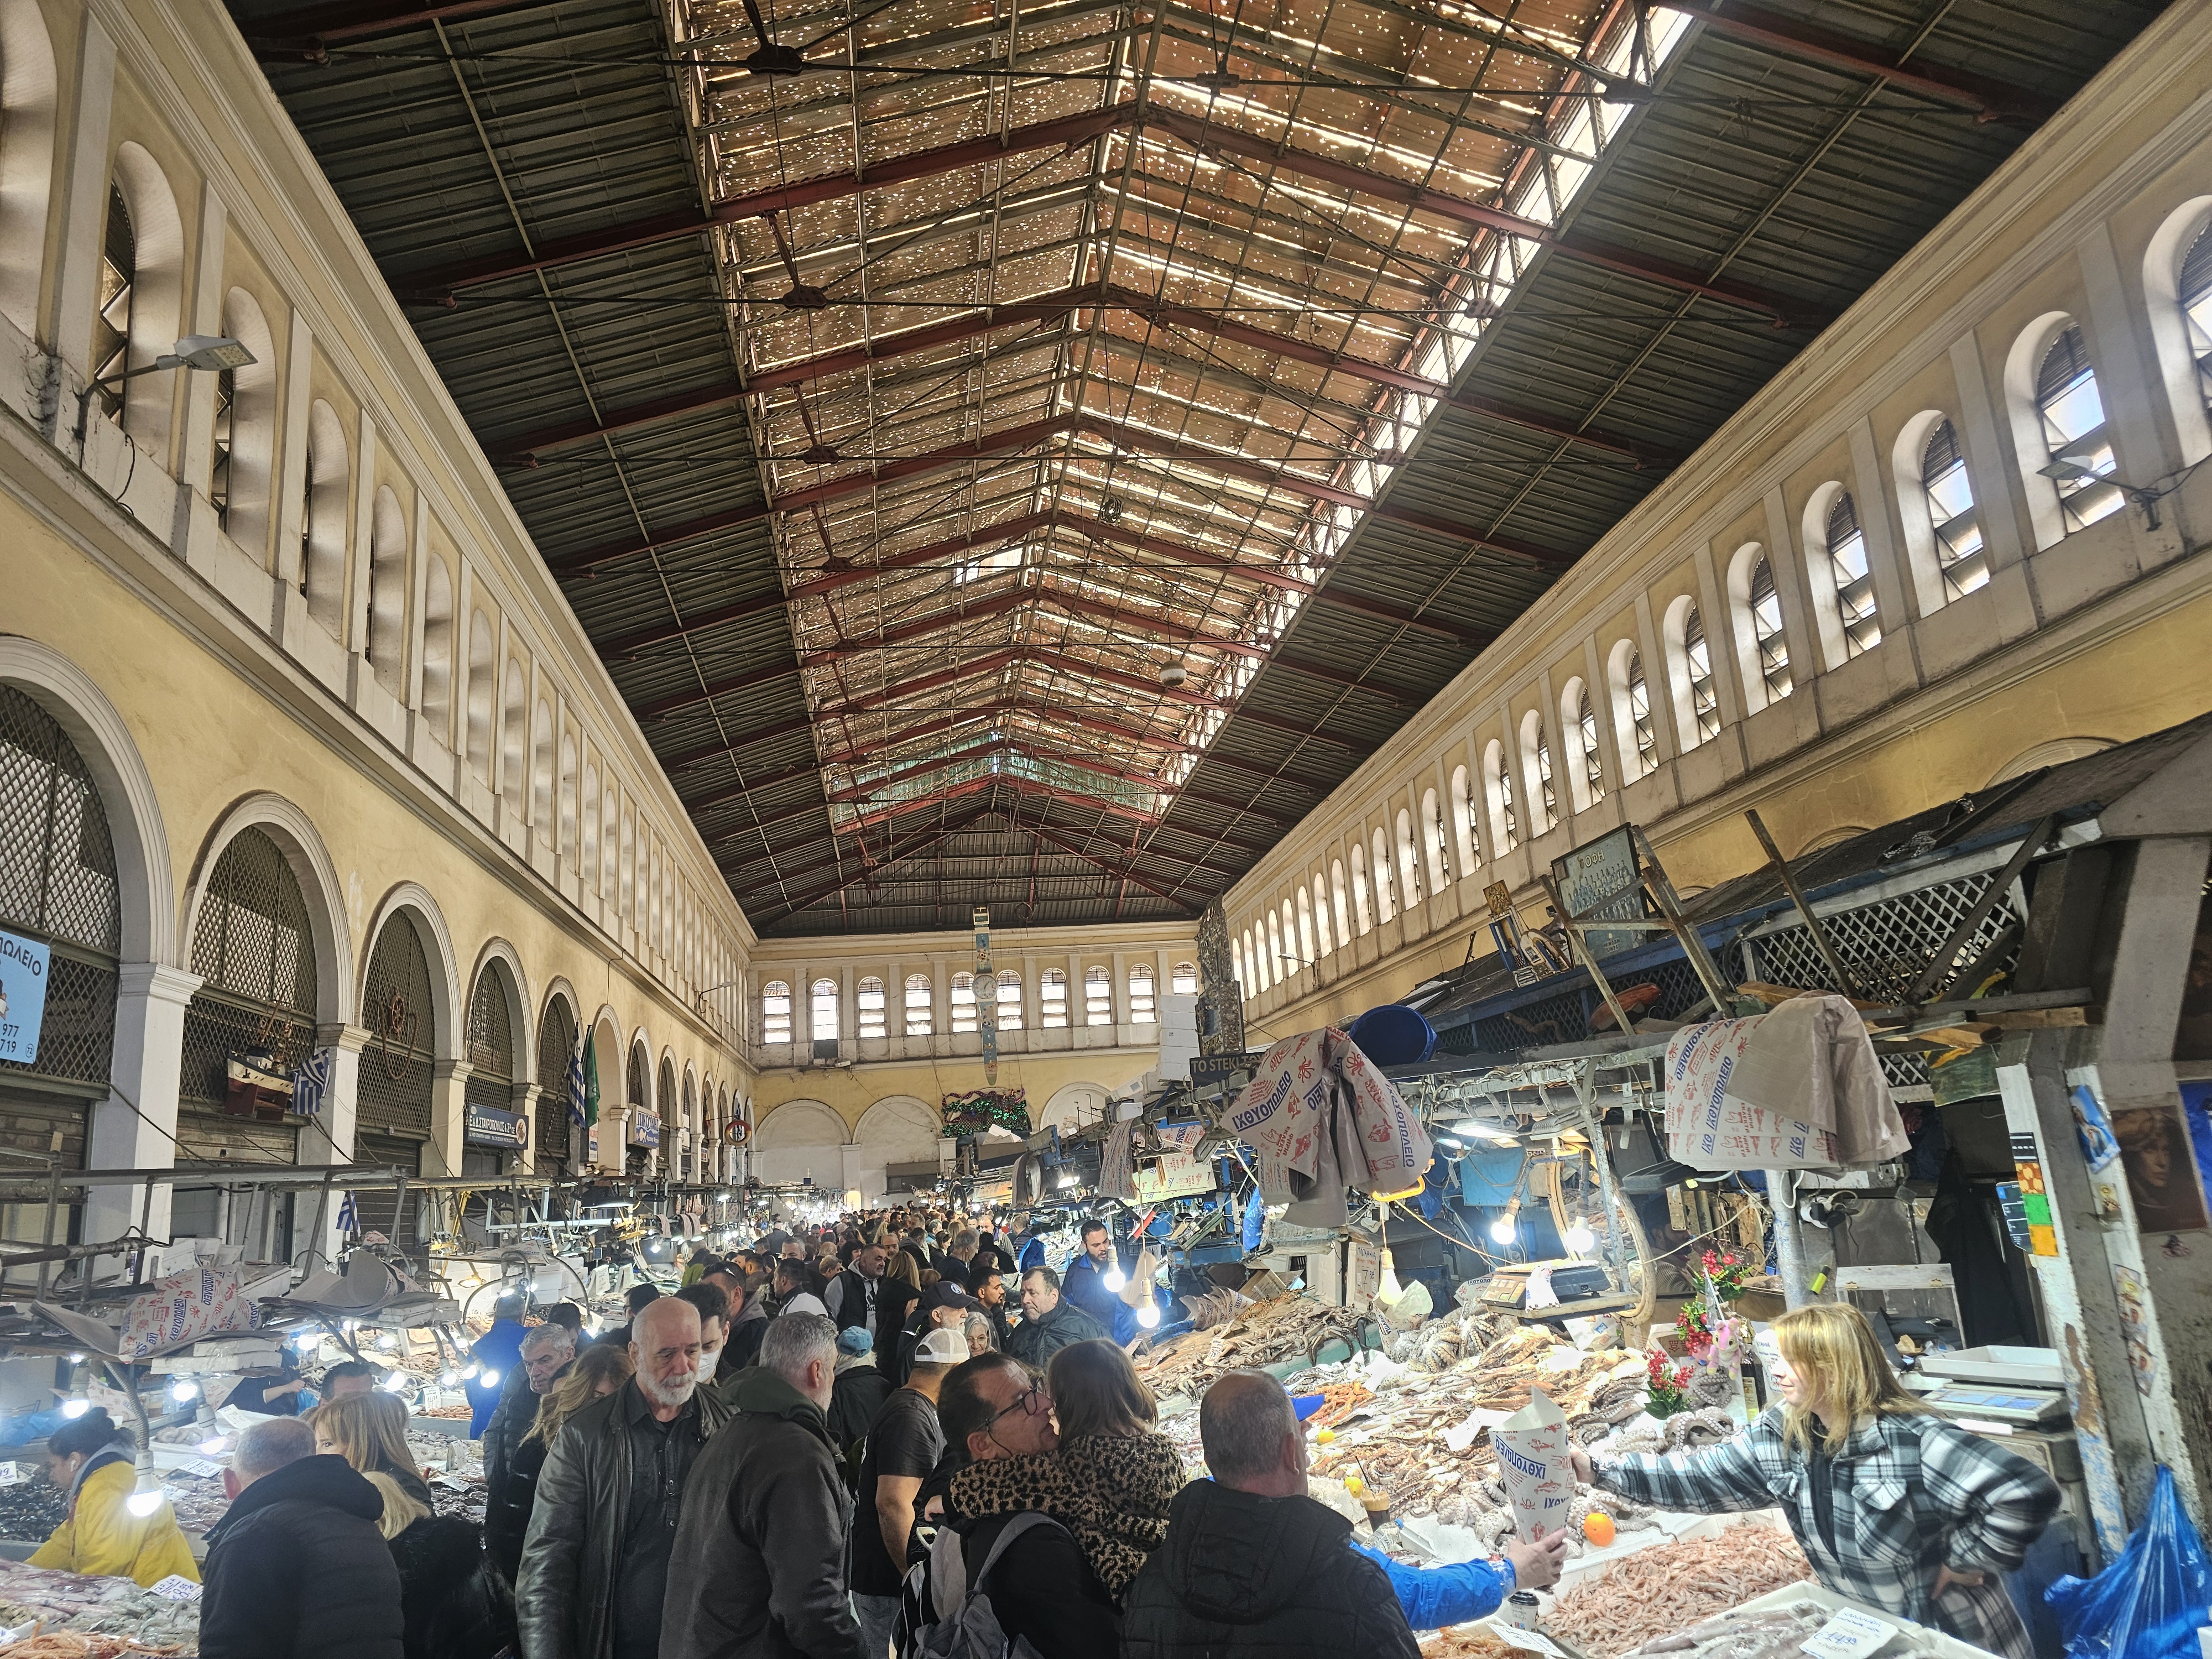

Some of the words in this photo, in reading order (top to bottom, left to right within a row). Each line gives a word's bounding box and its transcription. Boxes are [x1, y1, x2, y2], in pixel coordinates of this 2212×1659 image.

[1585, 849, 1605, 867] ΟΦΗ
[3, 1024, 19, 1037] 977
[1191, 1060, 1207, 1073] TO
[1209, 1057, 1239, 1072] STEKI
[1232, 1071, 1292, 1130] ΙΧΘΥΟΠΩΛΕΙΟ
[1307, 1085, 1322, 1110] ΕΙΟ
[1705, 1056, 1732, 1130] ΙΧΘΥΟΠΩΛΕΙΟ
[1385, 1083, 1415, 1167] ΙΧΘΥΟΠΩΛΕΙΟ
[1741, 1102, 1750, 1133] ΕΚΛΕΚΤΑ
[1176, 1126, 1188, 1148] ΟΠΩΛΕΟ
[1275, 1126, 1291, 1157] ΕΚΛΕΚΤΑ
[169, 1298, 185, 1341] ΙΧΘΥΟΠΩΛΕΙΟ
[1496, 1438, 1546, 1479] ΙΧΘΥΟΠΩΛΕΙΟ
